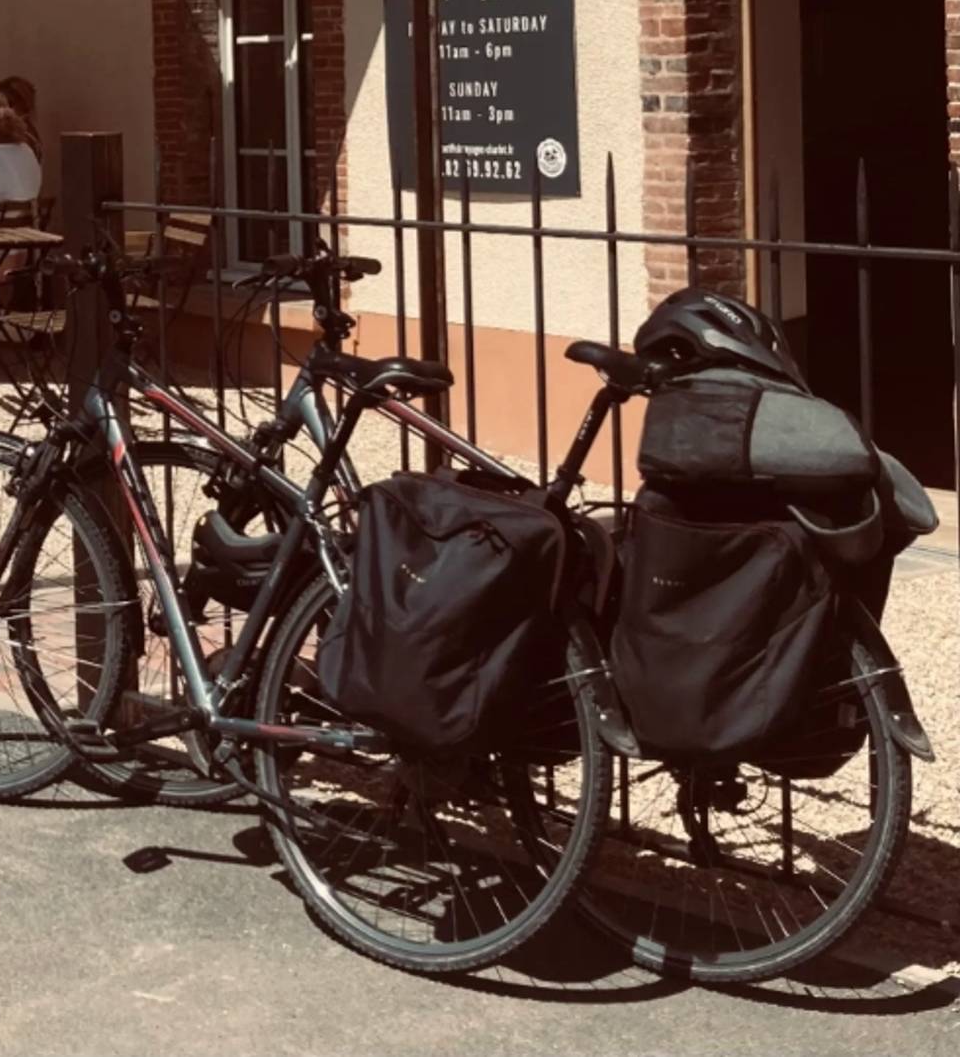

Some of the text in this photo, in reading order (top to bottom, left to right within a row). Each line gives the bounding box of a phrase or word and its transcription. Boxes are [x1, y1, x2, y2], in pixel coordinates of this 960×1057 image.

[460, 20, 475, 35] to
[478, 14, 548, 35] SATURDAY
[438, 44, 470, 59] 11am
[485, 41, 513, 62] 6pm
[448, 81, 499, 98] SUNDAY
[441, 105, 472, 122] 11am
[488, 105, 515, 124] 3pm
